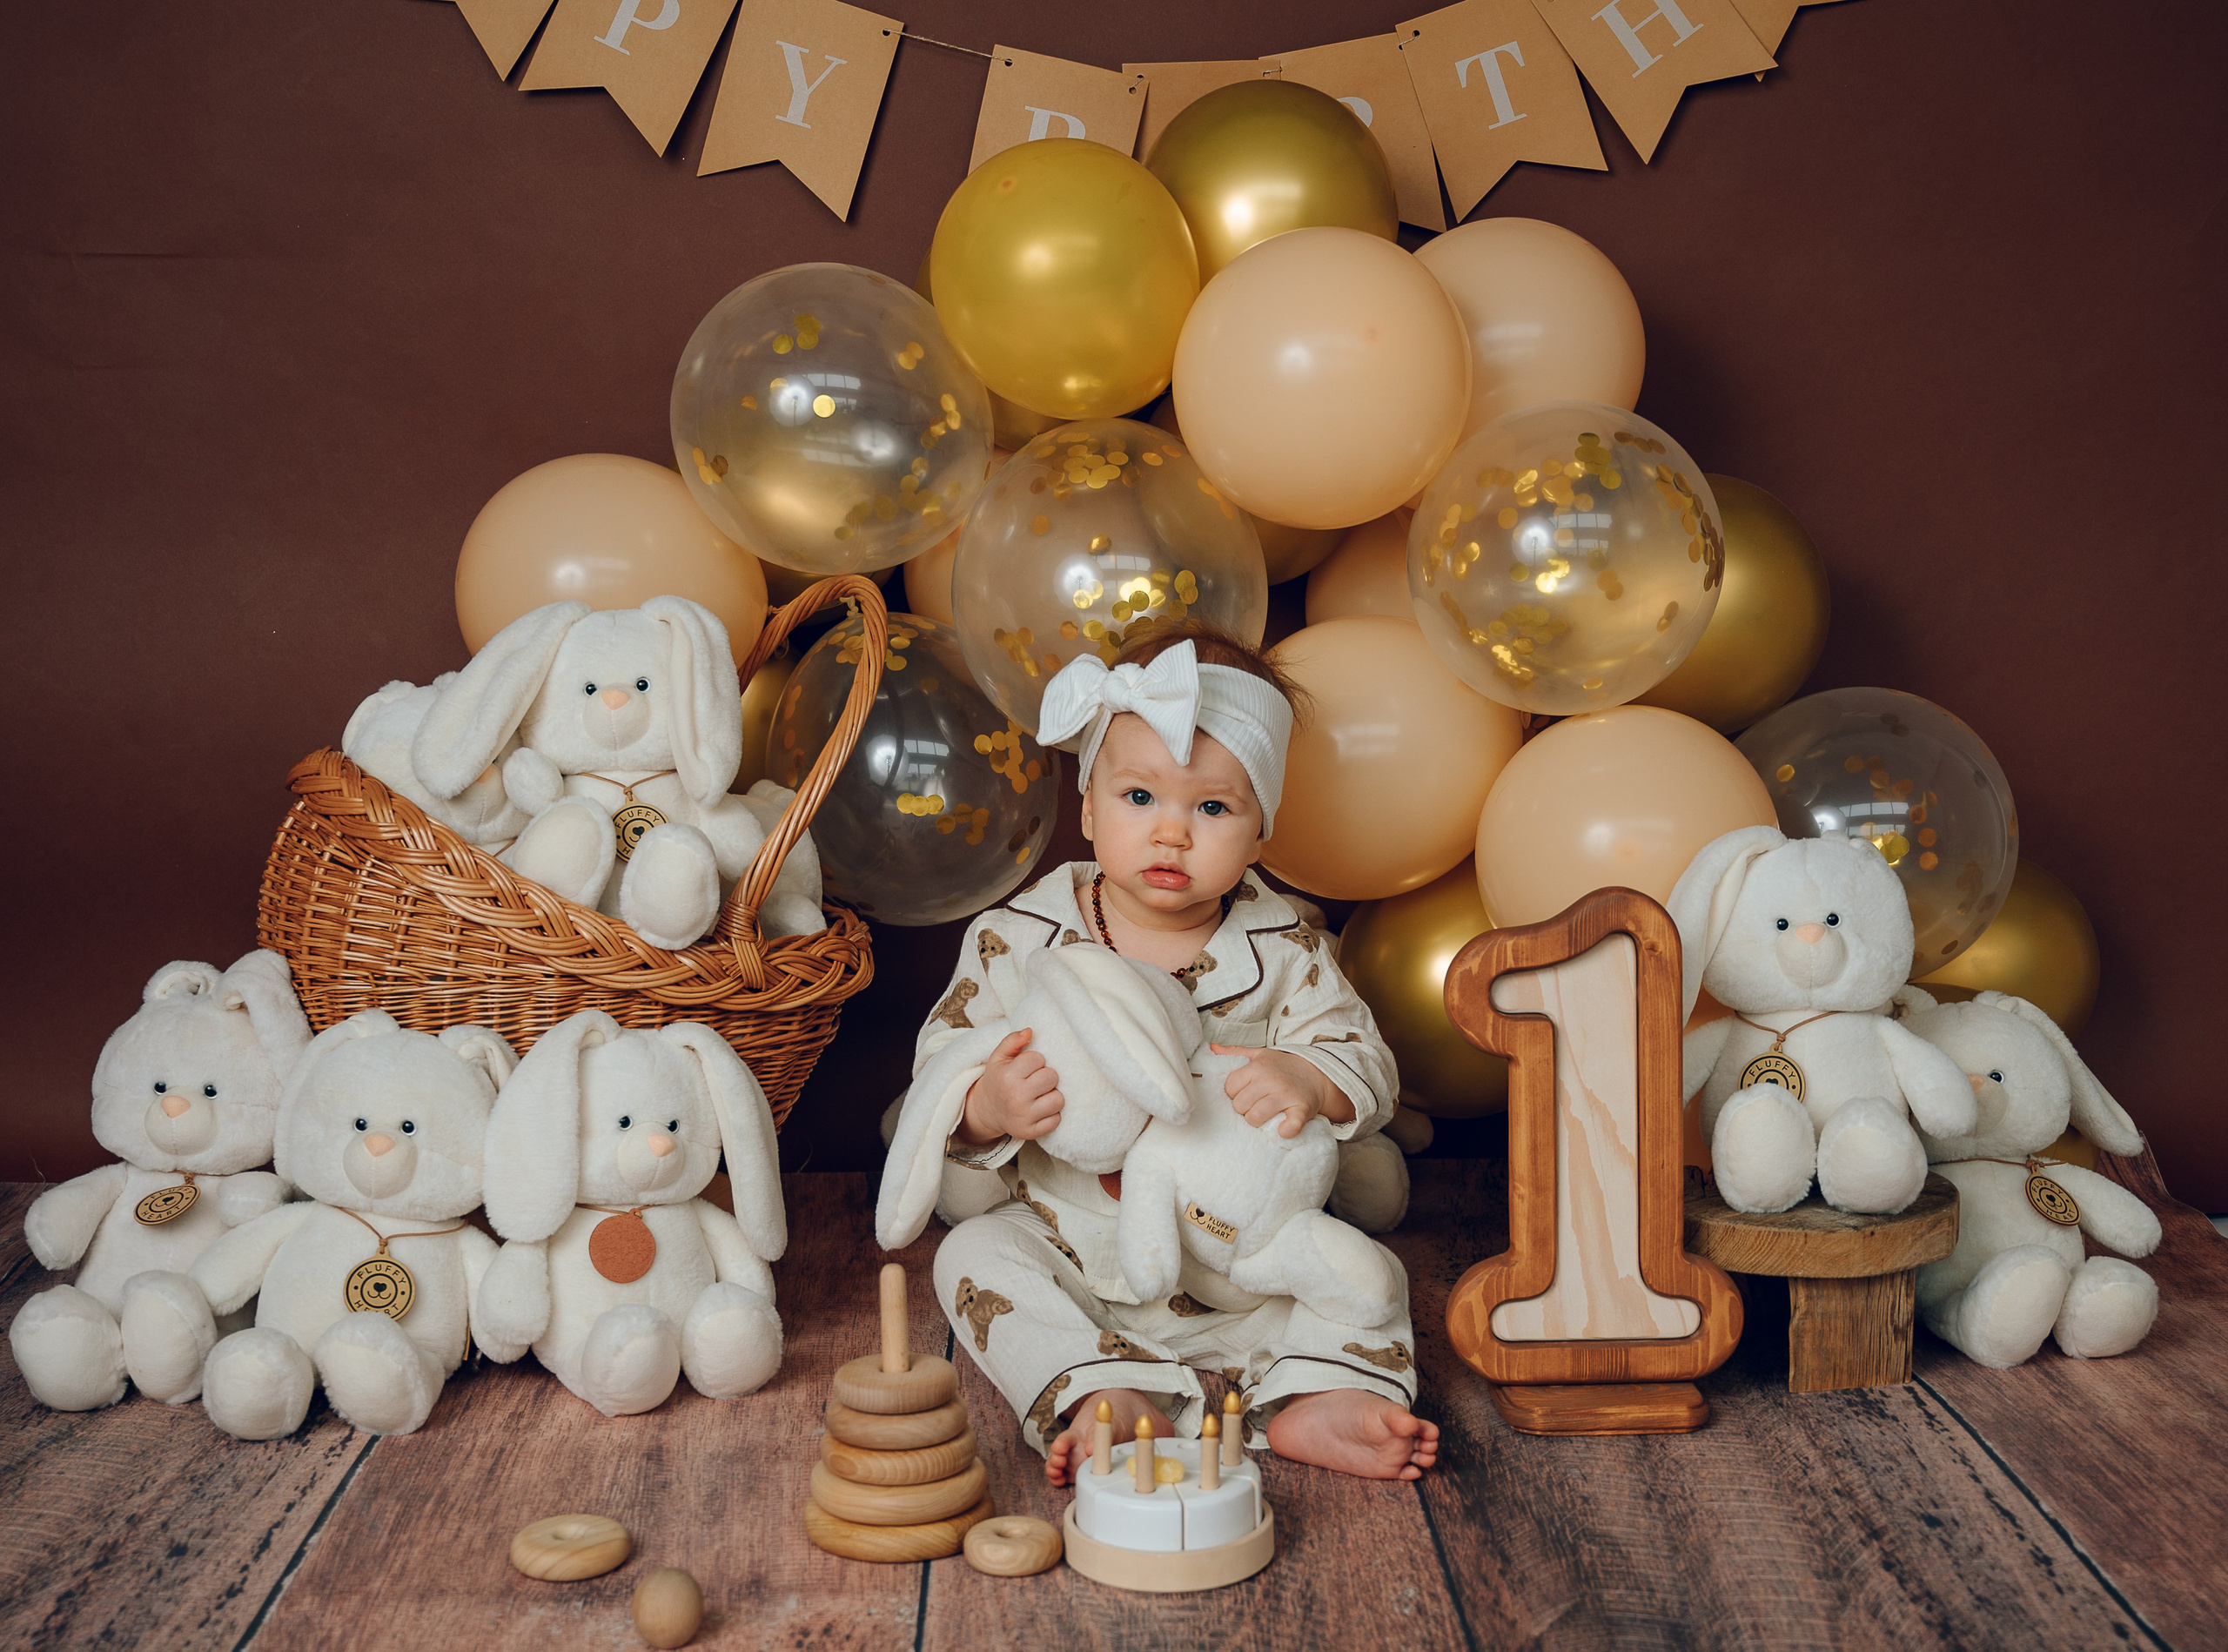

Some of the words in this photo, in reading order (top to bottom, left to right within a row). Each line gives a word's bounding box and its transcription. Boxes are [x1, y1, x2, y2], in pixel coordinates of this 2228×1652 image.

[614, 809, 660, 829] FLUFFY
[1748, 1060, 1796, 1078] FLUFFY
[2031, 1179, 2064, 1194] FLUFFY
[141, 1205, 181, 1219] HEART
[2046, 1208, 2076, 1220] HEART
[1206, 1224, 1231, 1239] HEART
[1208, 1216, 1235, 1232] FLUFFY
[356, 1264, 406, 1284] FLUFFY
